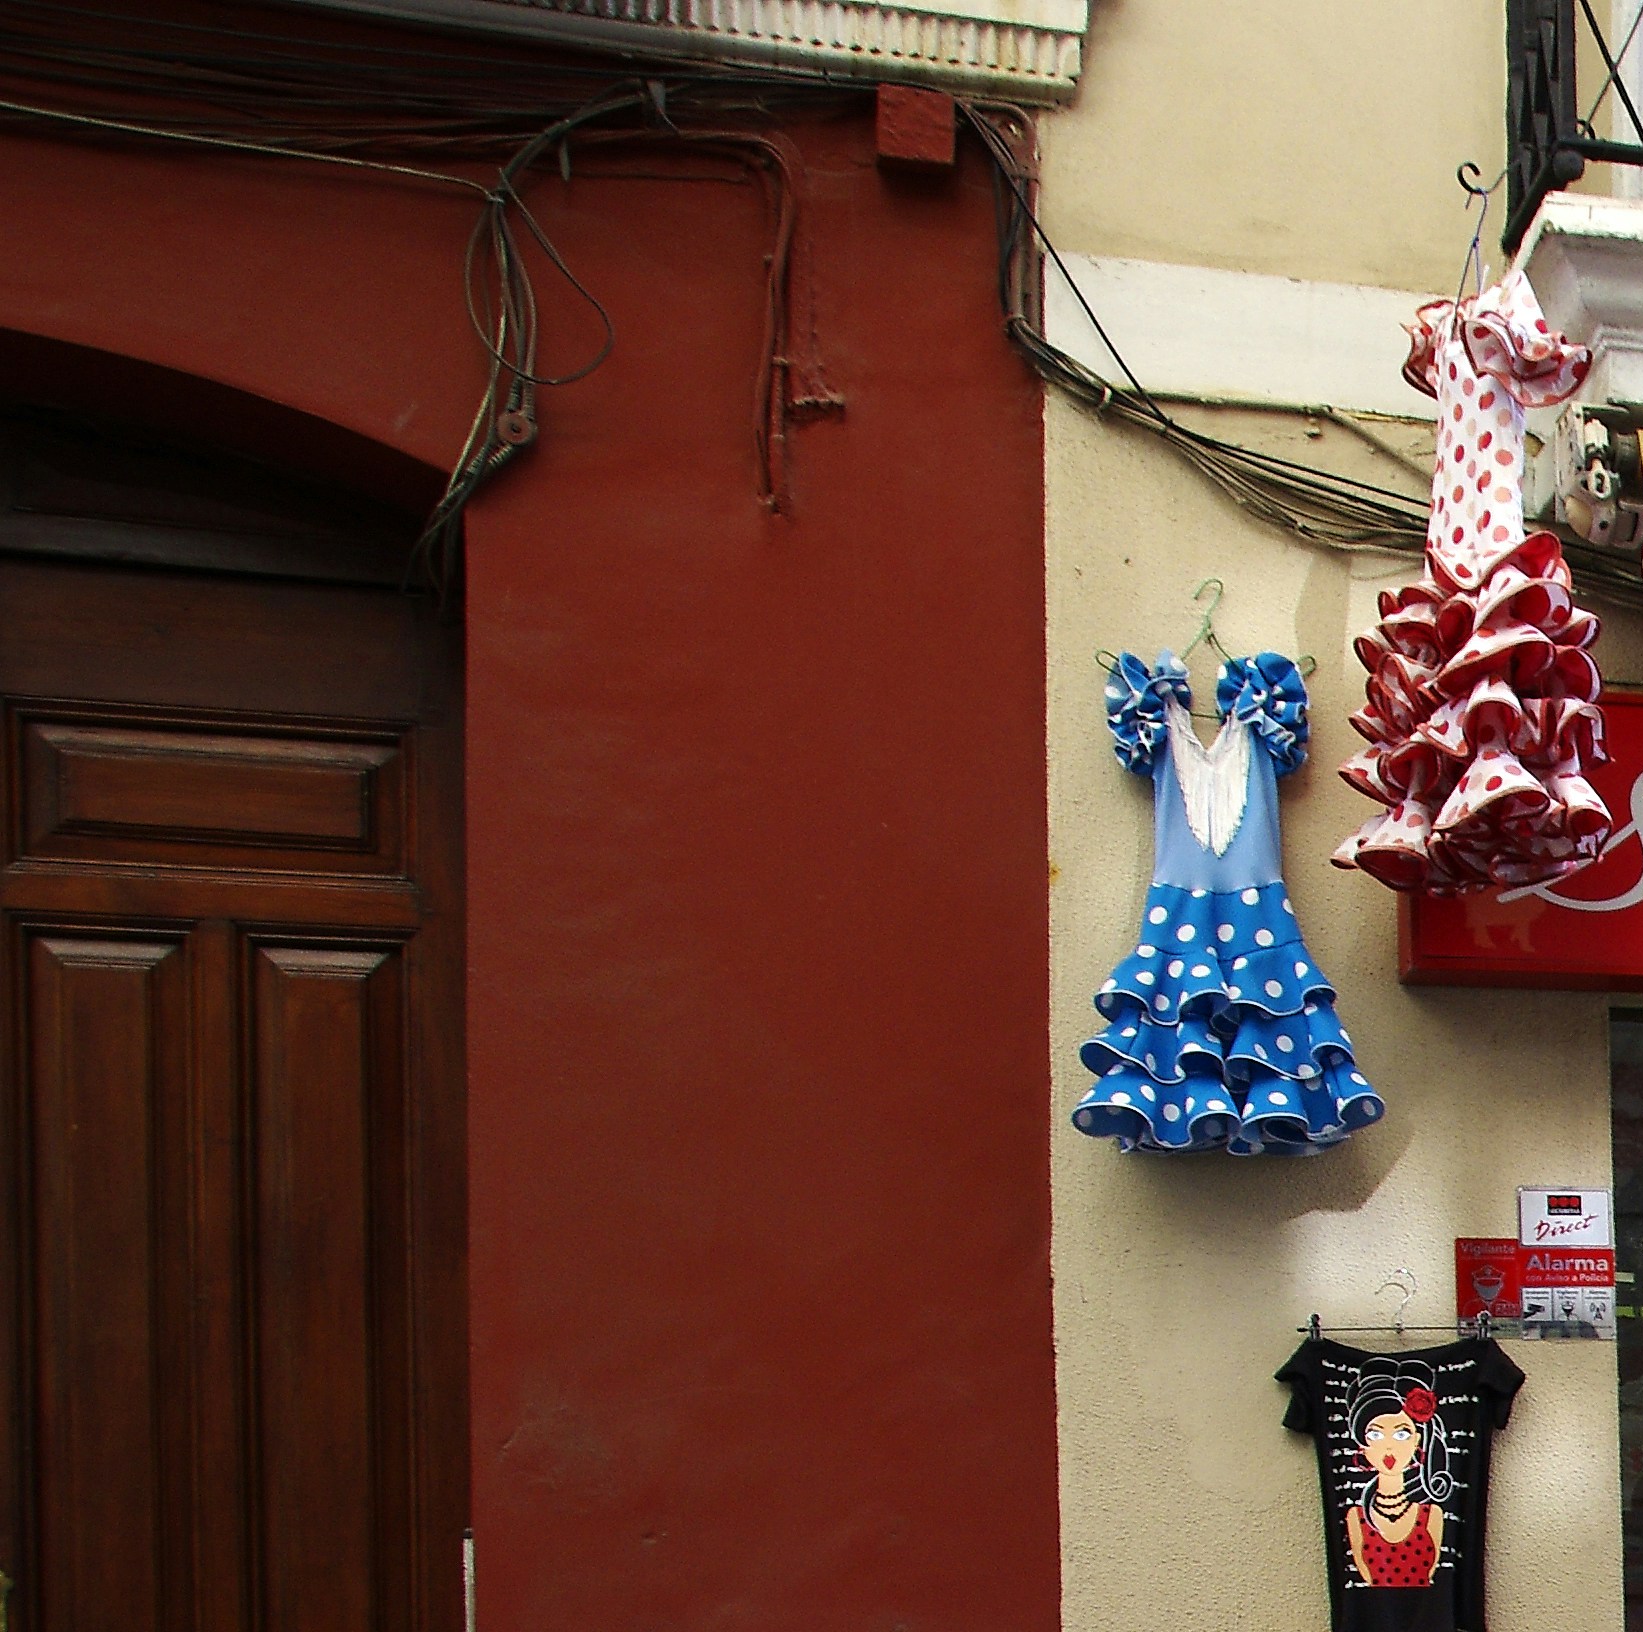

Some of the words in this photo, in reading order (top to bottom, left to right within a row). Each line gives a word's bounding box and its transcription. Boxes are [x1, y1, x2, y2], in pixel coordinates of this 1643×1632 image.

[1534, 1214, 1600, 1242] Direct
[1459, 1241, 1516, 1256] Vigilante
[1526, 1253, 1608, 1271] Alarma
